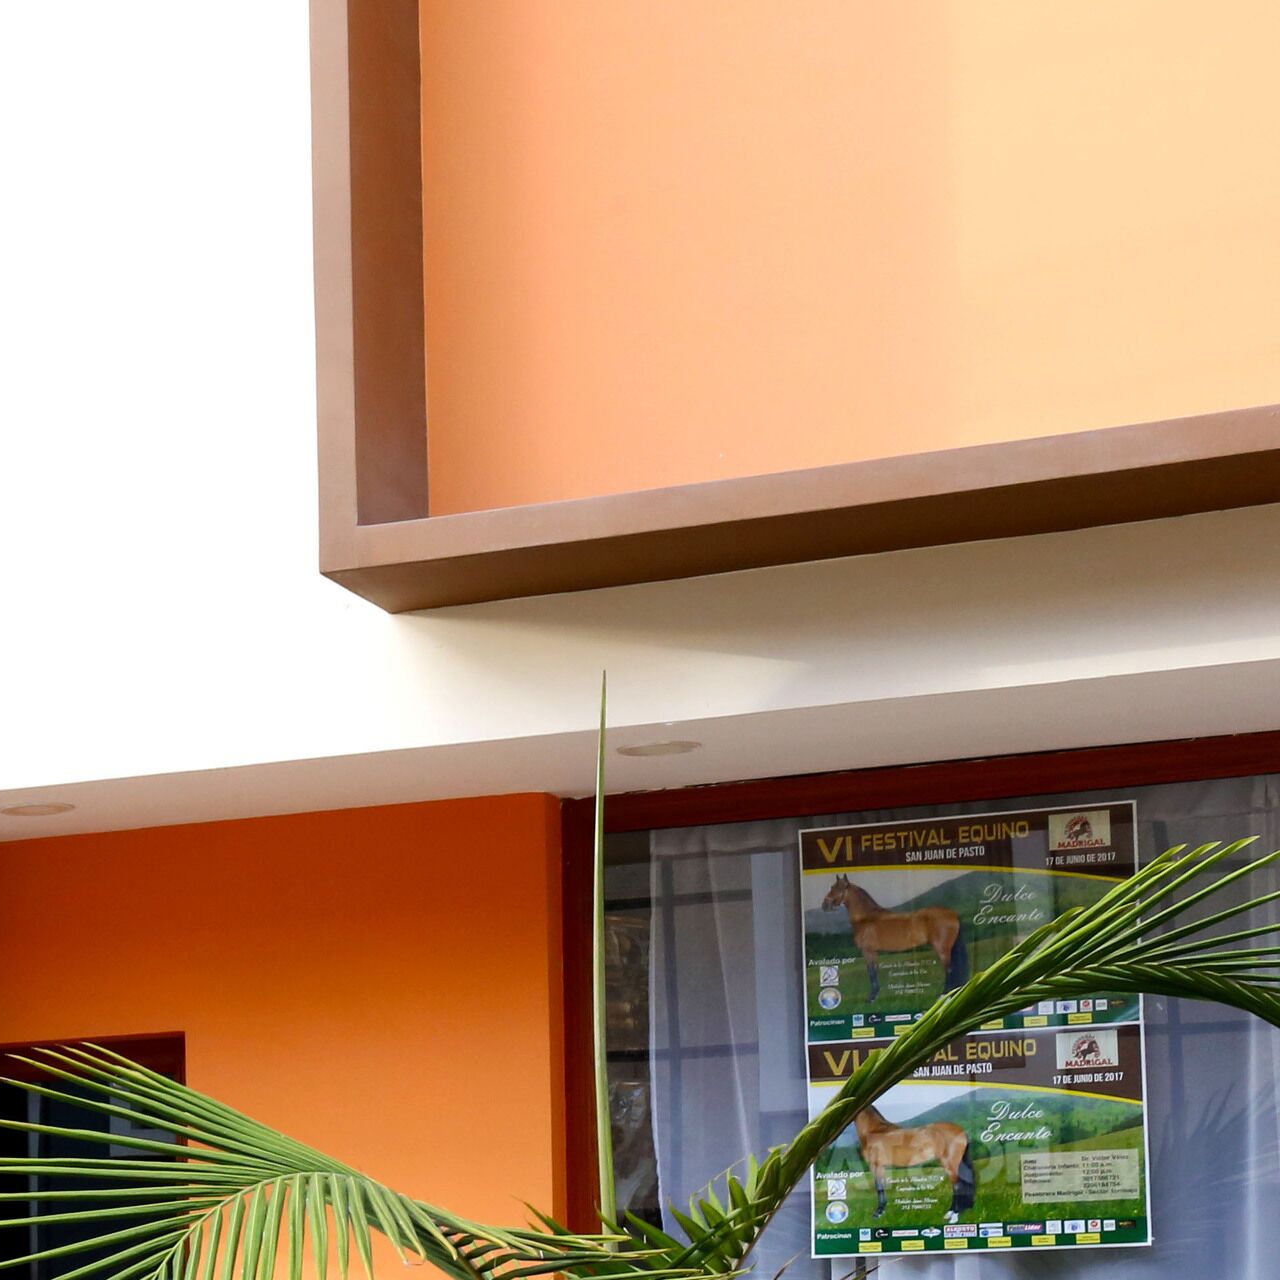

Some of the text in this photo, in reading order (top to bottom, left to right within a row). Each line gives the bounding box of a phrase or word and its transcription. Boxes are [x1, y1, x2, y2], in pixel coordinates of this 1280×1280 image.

[816, 820, 1030, 863] VI FESTIVAL EQUINO
[1056, 838, 1106, 849] MADRIGAL
[905, 845, 986, 862] SAN JUAN DE PASTO
[1045, 851, 1116, 866] 17 DE JUNIO DE 2017
[980, 883, 1037, 904] Dulce
[972, 904, 1045, 926] Encanto
[808, 956, 856, 967] Avalado por
[966, 1038, 1038, 1060] EQUINO
[913, 1062, 993, 1078] SAN JUAN DE PASTO
[1065, 1058, 1113, 1068] MADRIGAL
[1053, 1071, 1124, 1085] 17 DE JUNIO DE 2017
[986, 1101, 1045, 1121] Dulce
[980, 1121, 1053, 1143] Encanto
[816, 1171, 864, 1180] Avalado por
[816, 1232, 852, 1240] Patrocinan
